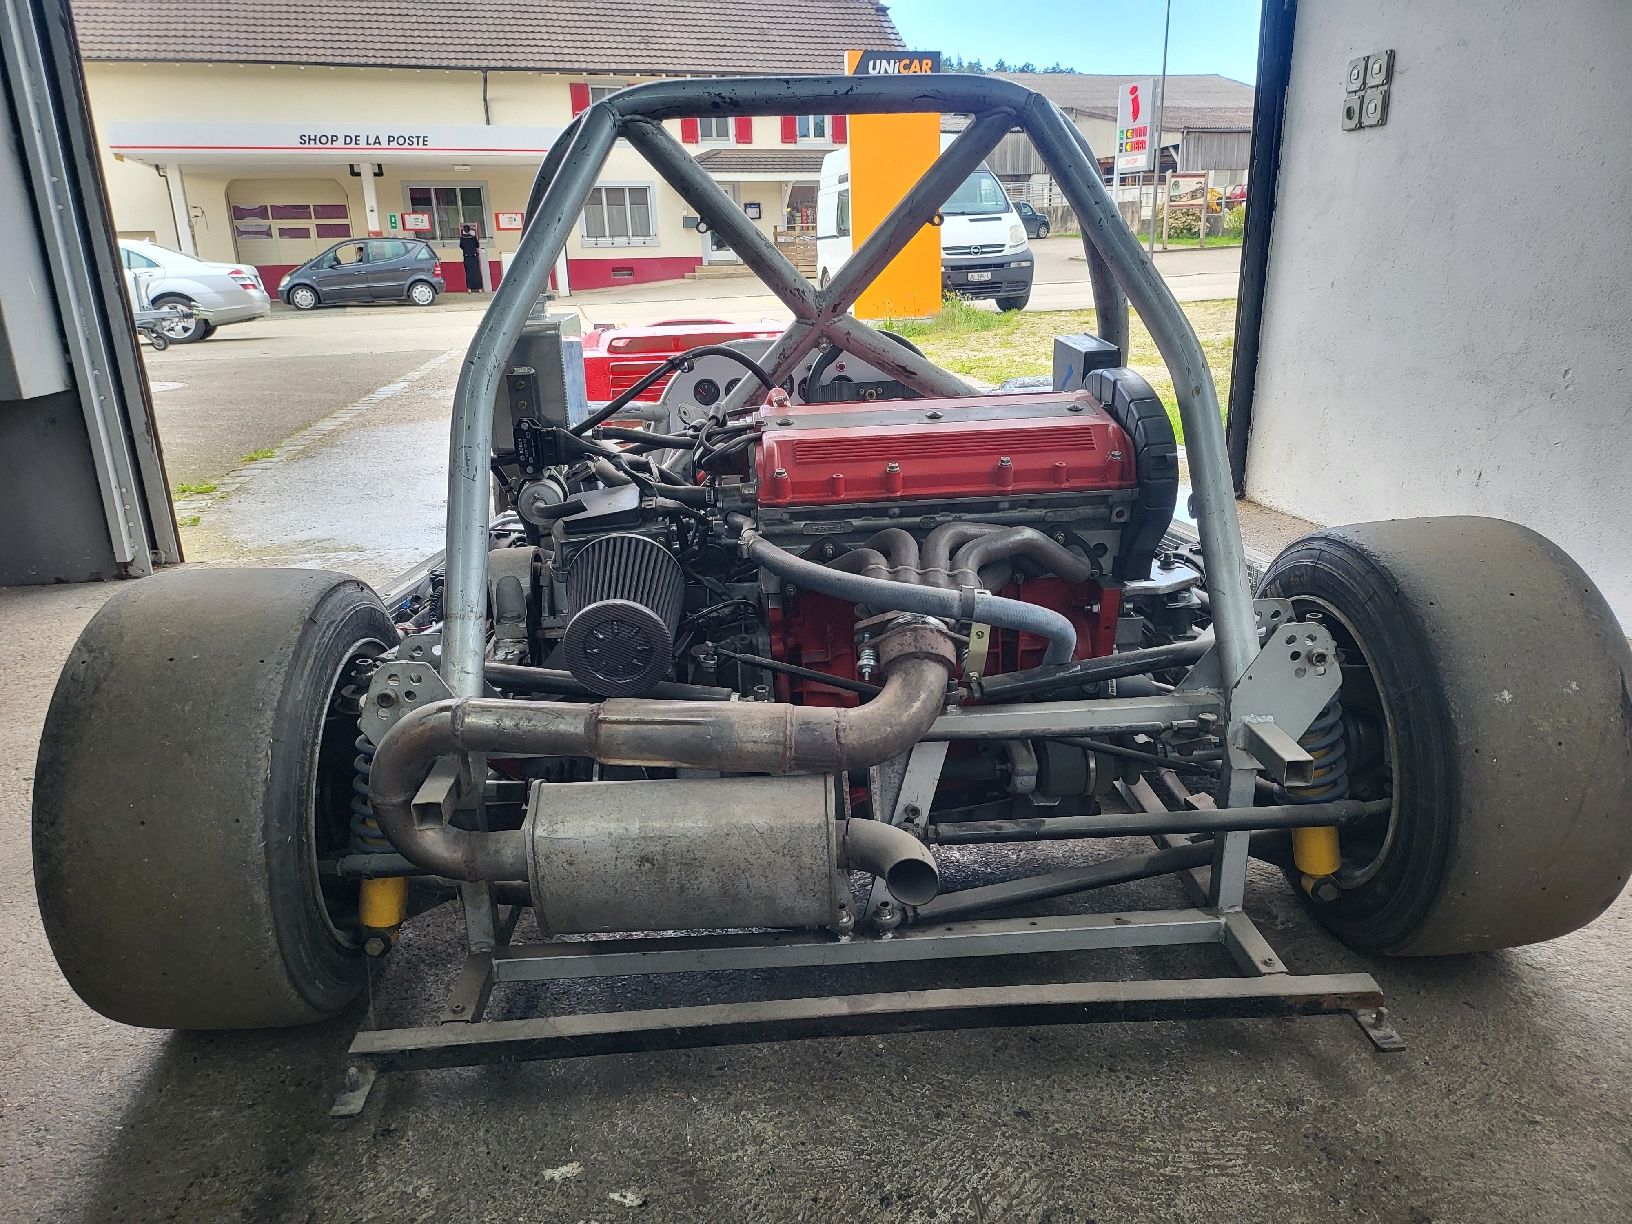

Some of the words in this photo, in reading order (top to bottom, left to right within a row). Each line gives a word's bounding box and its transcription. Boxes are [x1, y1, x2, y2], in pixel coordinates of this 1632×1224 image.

[299, 134, 339, 145] SHOP
[343, 135, 361, 146] DE
[366, 135, 382, 146] LA
[387, 135, 429, 147] POSTE
